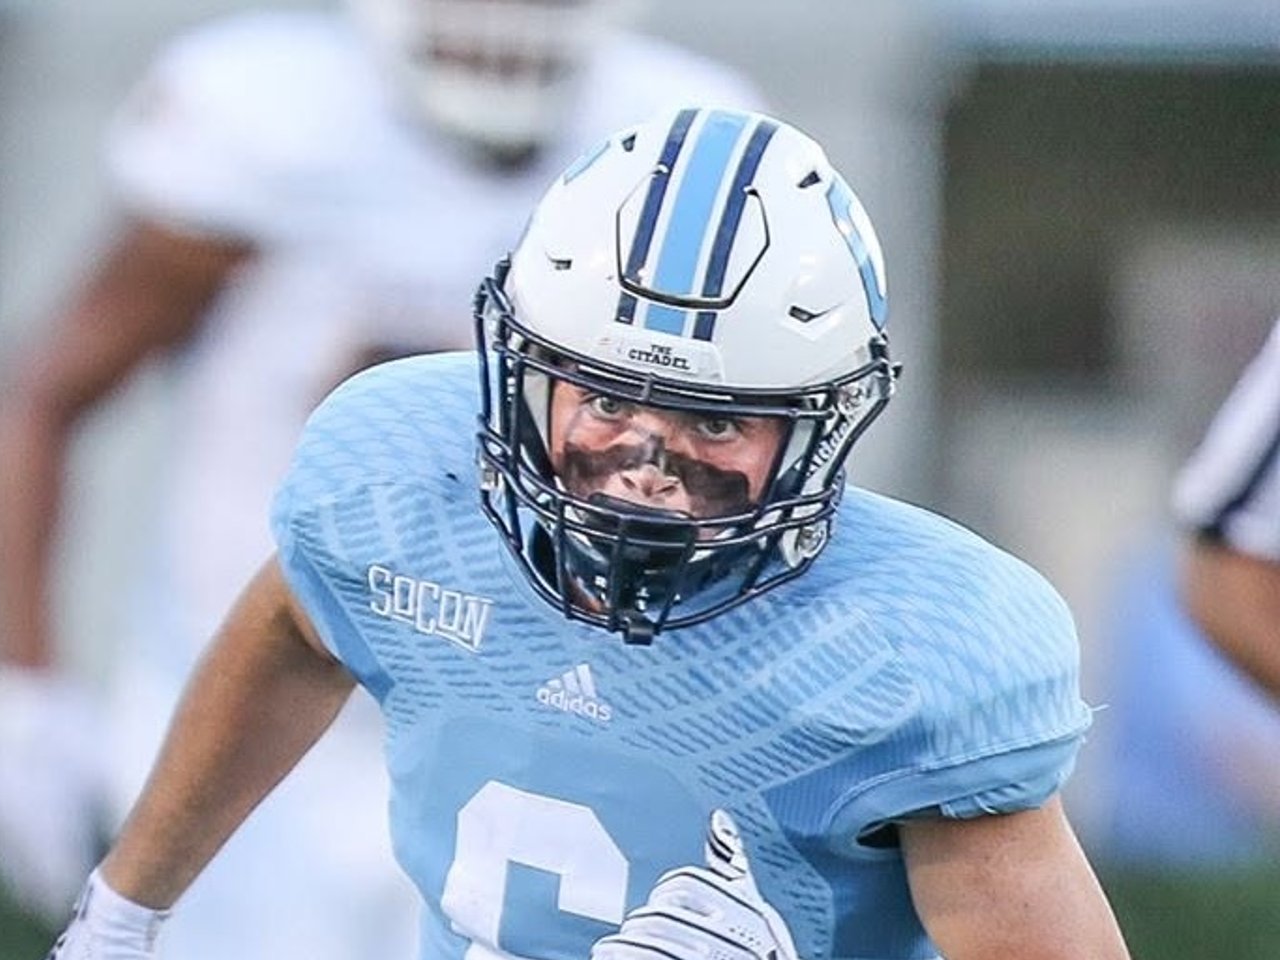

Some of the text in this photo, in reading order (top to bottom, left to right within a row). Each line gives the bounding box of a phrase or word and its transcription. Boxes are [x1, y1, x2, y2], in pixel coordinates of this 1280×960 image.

[628, 348, 691, 370] CITADEL
[368, 565, 494, 652] SOCON
[536, 687, 612, 720] adidas
